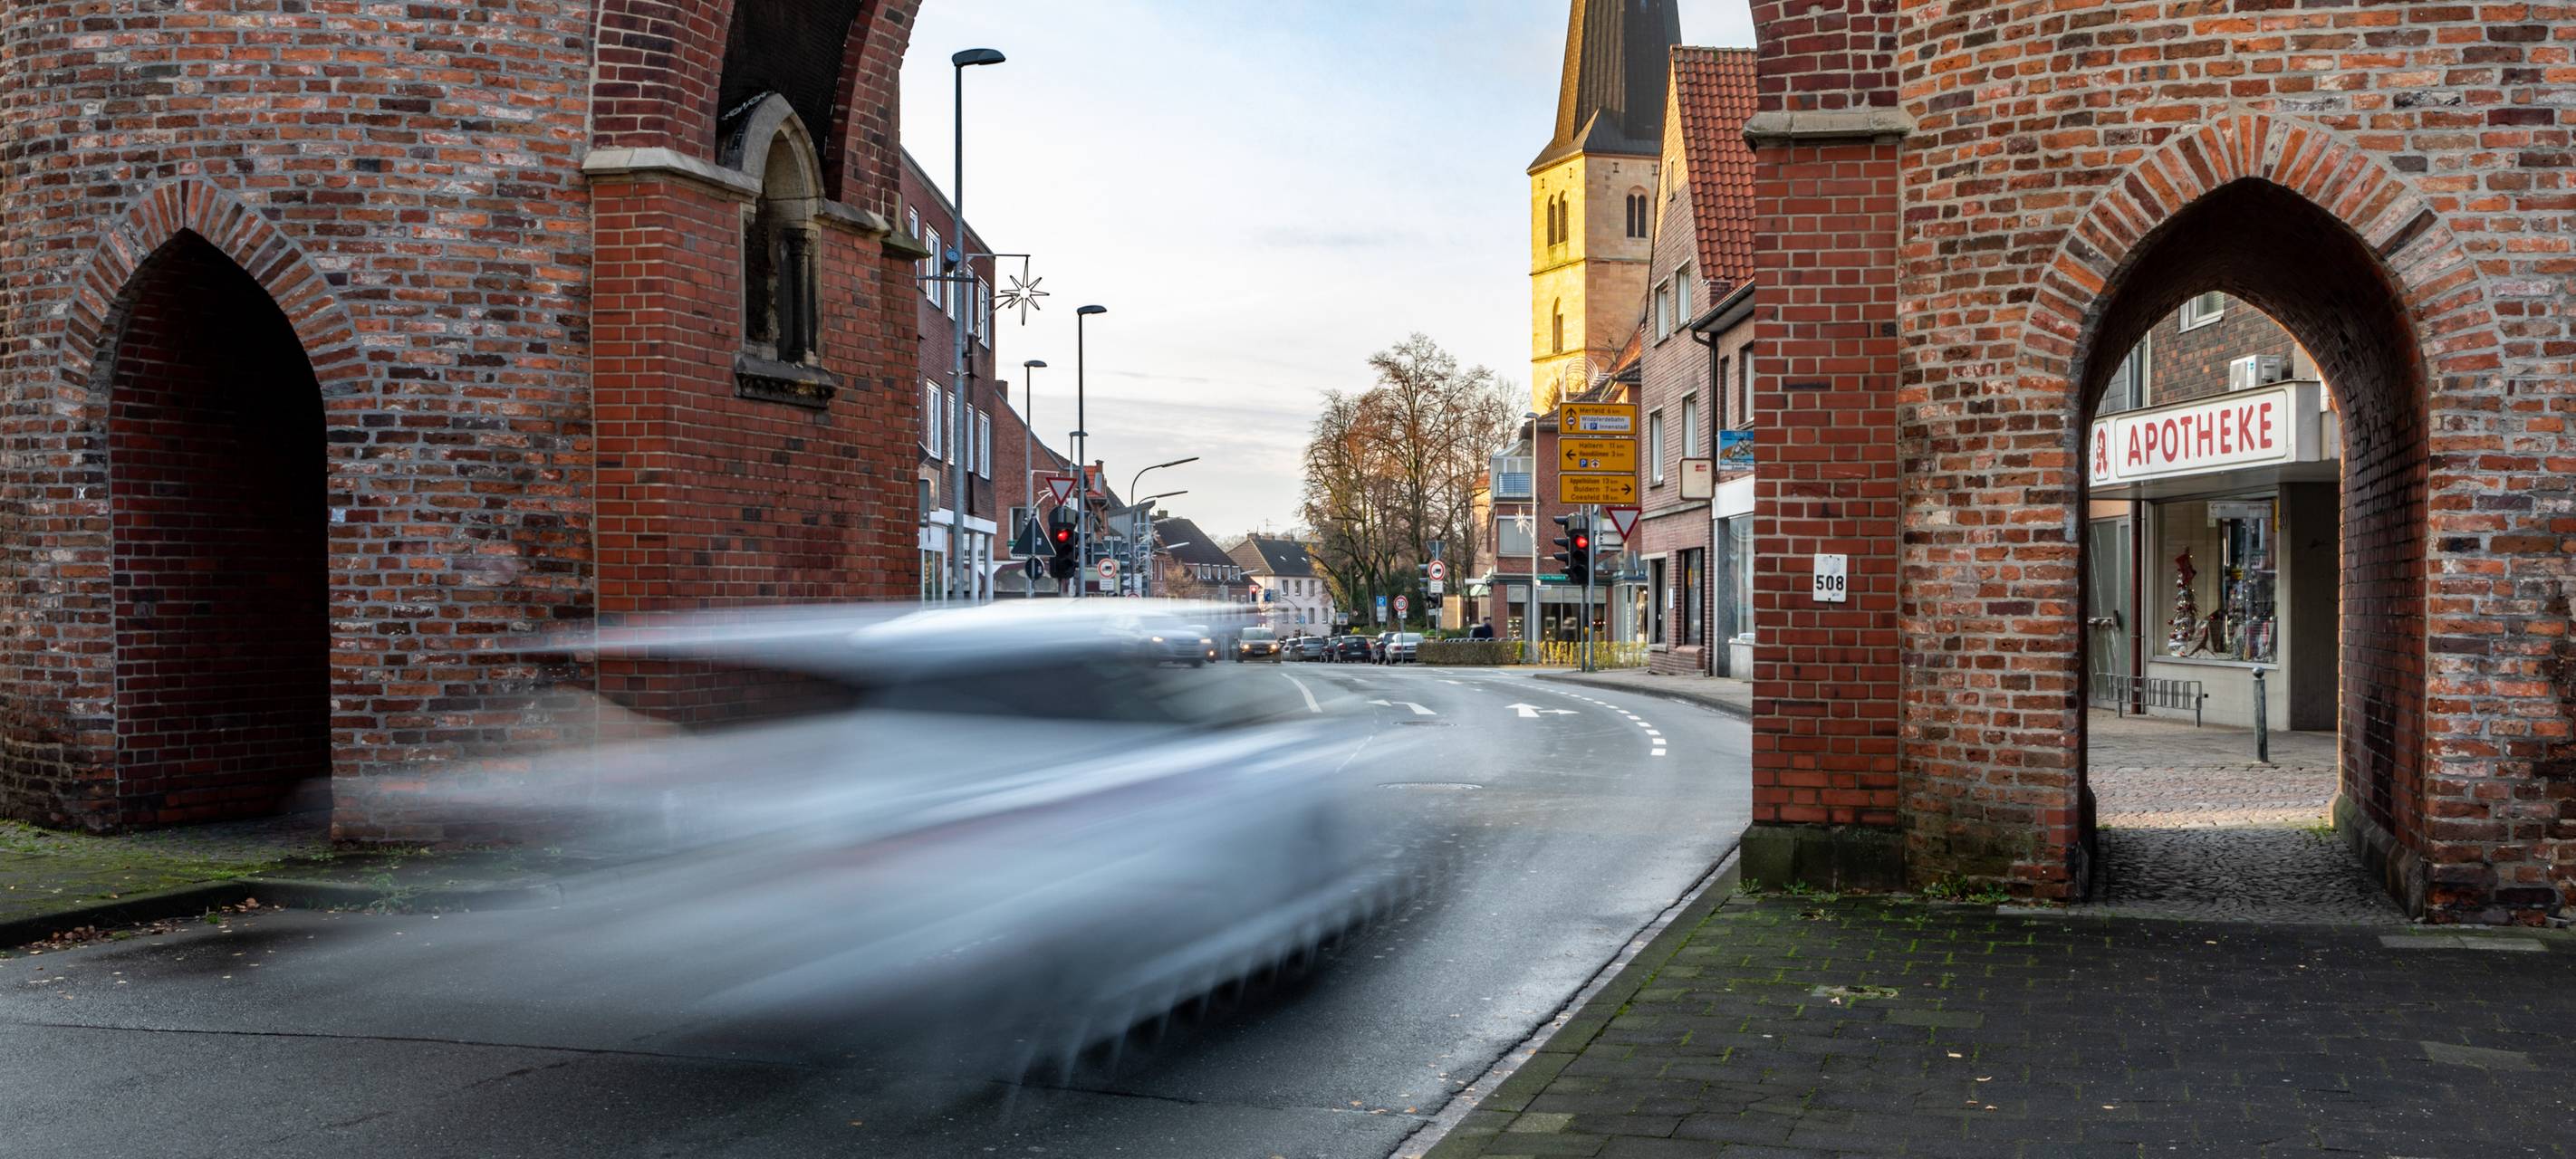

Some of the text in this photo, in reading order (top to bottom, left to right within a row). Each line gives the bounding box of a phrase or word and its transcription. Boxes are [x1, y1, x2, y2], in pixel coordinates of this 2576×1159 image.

[2127, 401, 2273, 468] APOTHEKE
[1579, 441, 1603, 449] Haltern
[1610, 441, 1615, 449] 11
[1816, 574, 1844, 590] 508
